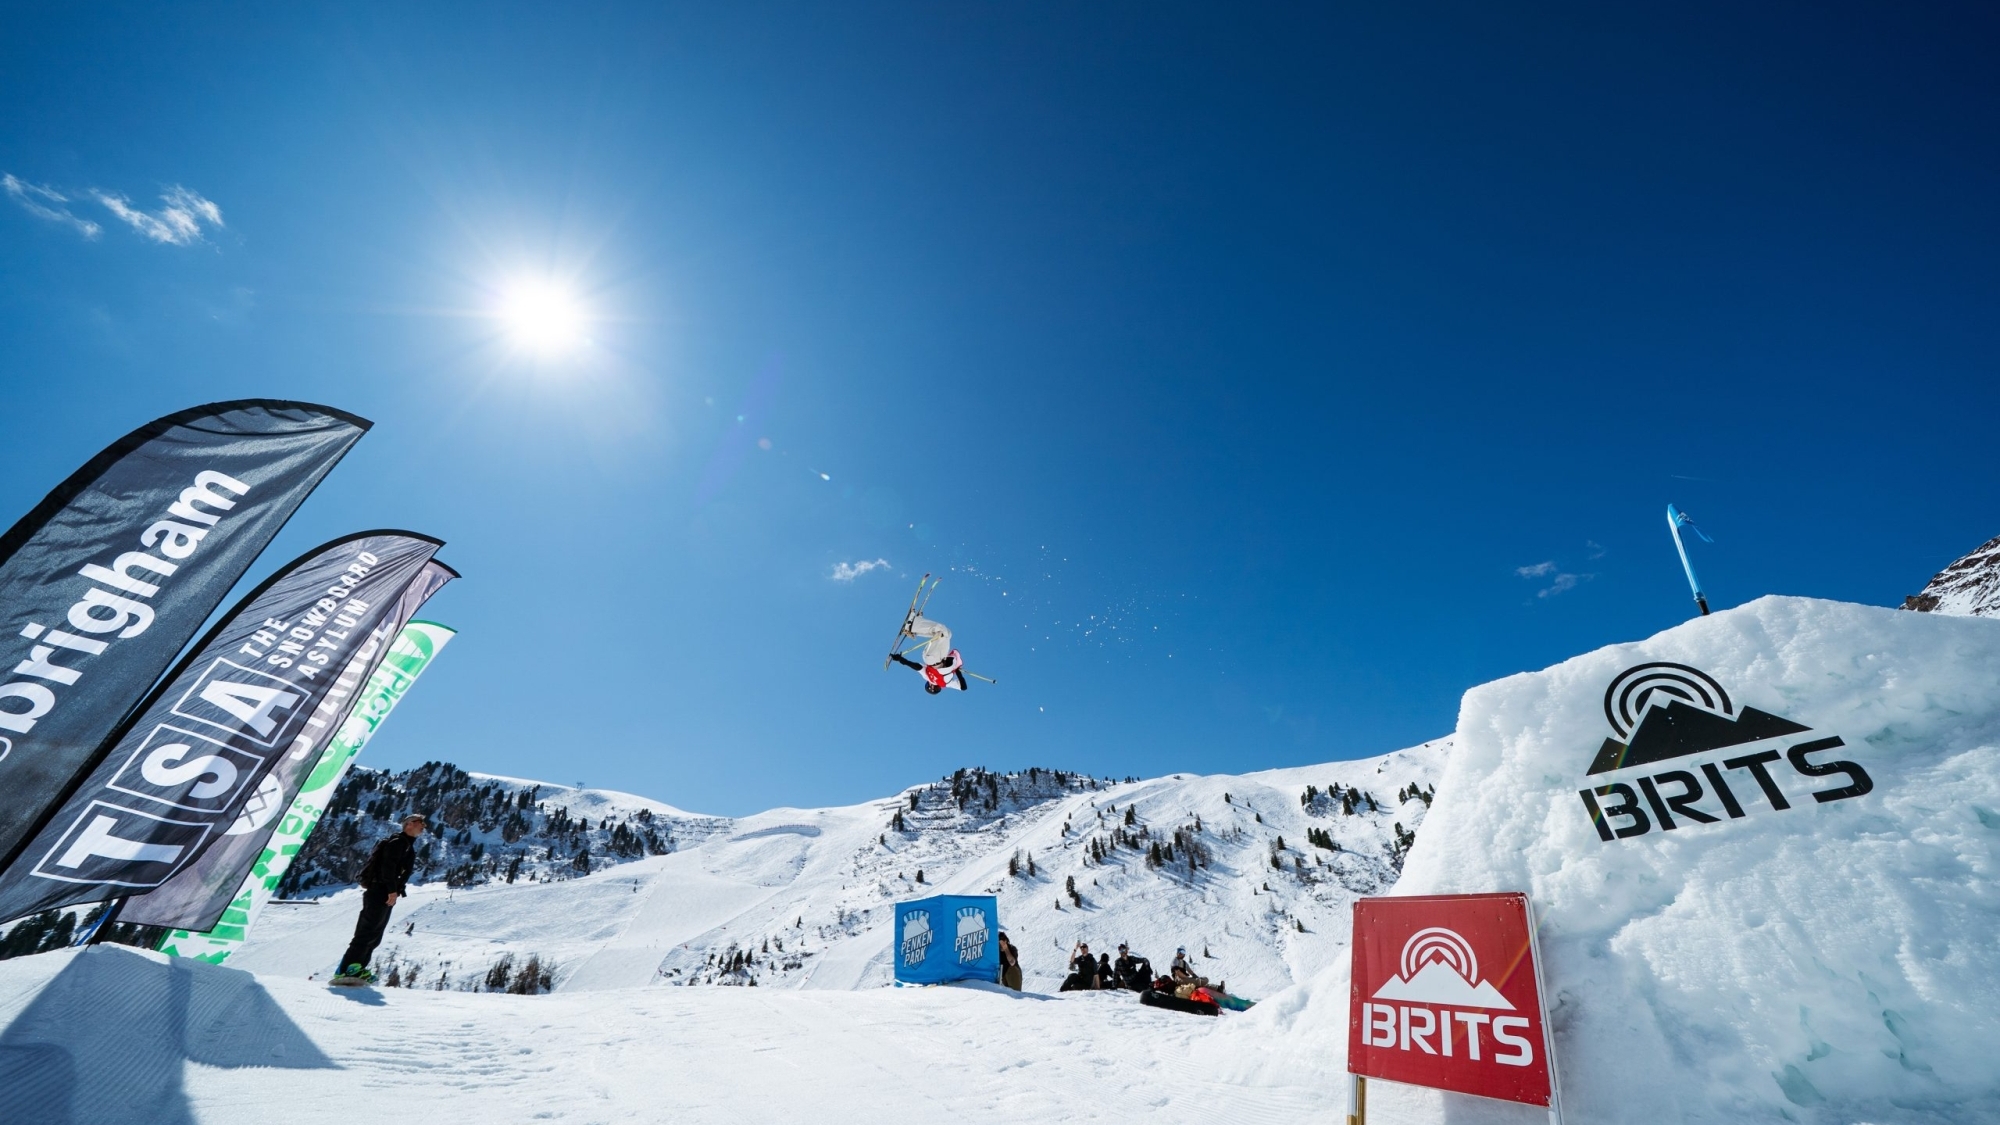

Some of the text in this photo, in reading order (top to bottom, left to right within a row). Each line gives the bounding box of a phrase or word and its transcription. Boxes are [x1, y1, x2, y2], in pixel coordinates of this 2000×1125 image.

[267, 551, 379, 669] SNOWBOARD
[239, 618, 291, 658] THE
[297, 598, 370, 681] ASYLUM
[56, 680, 301, 871] TSA
[1578, 735, 1874, 842] BRITS
[901, 929, 933, 956] PENKEN
[904, 946, 926, 968] PARK
[955, 928, 989, 952] PENKEN
[959, 943, 983, 964] PARK
[1362, 1002, 1534, 1067] BRITS
